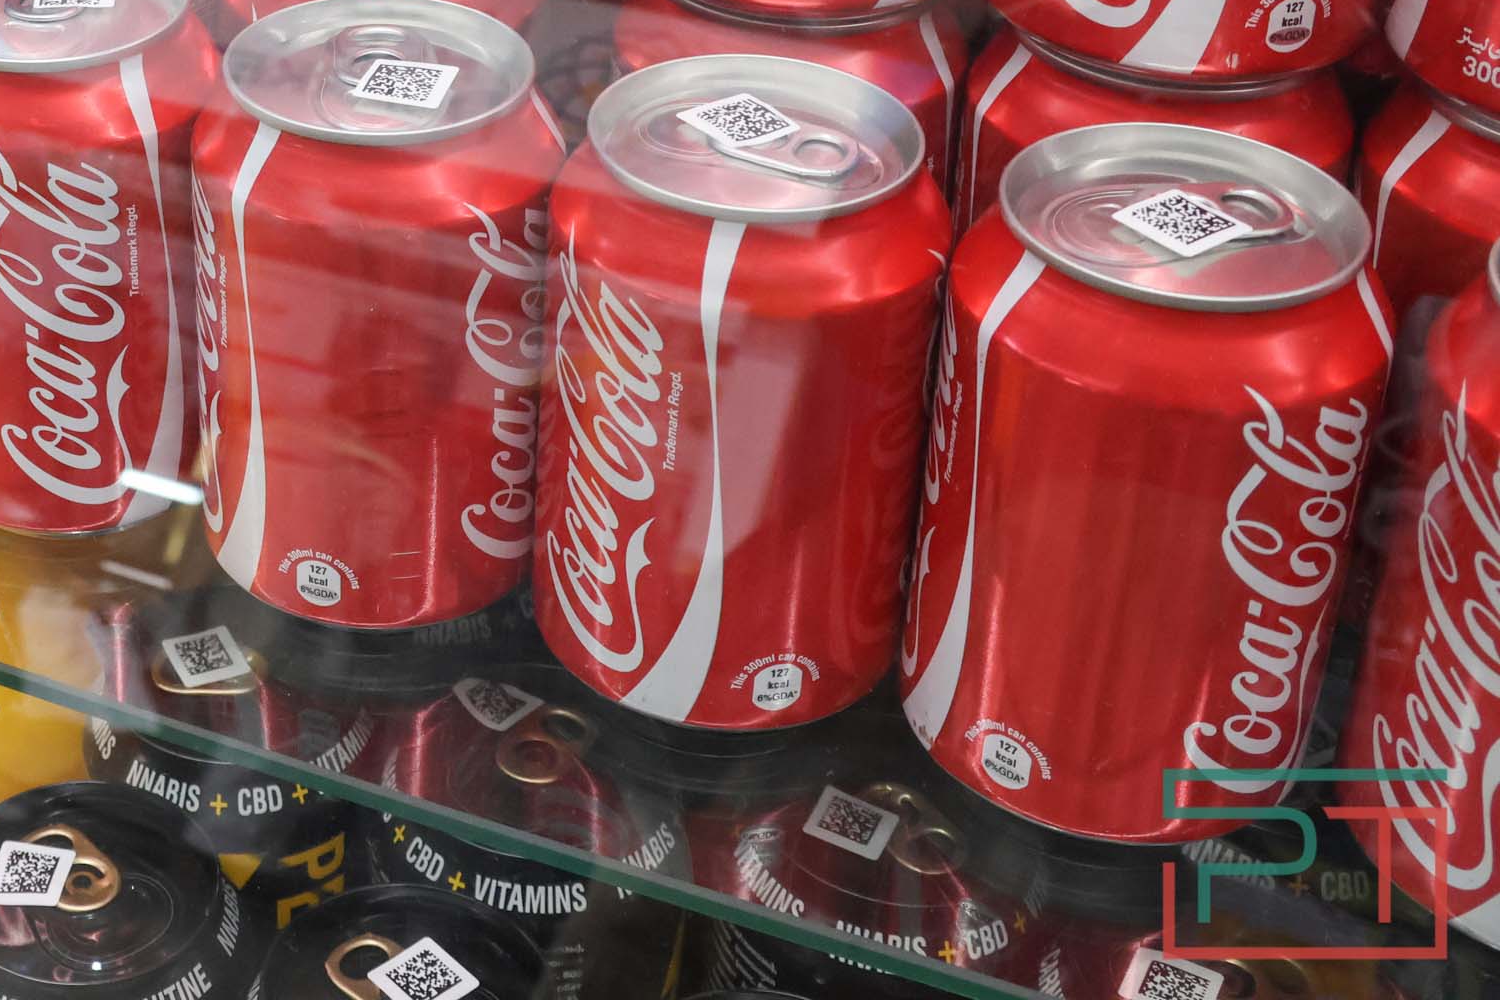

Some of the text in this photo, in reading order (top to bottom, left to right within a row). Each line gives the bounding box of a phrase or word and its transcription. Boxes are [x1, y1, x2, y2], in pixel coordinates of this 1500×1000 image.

[1244, 8, 1264, 29] This
[1281, 15, 1304, 27] kcal
[1286, 1, 1305, 13] 127
[126, 203, 140, 297] Trademark Regd.
[219, 289, 229, 349] Trademark
[460, 202, 550, 560] Coca-Cola
[661, 371, 683, 472] Trademark Regd.
[547, 219, 664, 673] Coca-Cola
[308, 575, 329, 587] kcal
[310, 564, 328, 576] 127
[315, 551, 333, 562] can
[333, 559, 361, 590] contains
[1183, 384, 1369, 794] Coca-Cola
[730, 672, 749, 690] This
[743, 653, 776, 674] 300ml
[778, 653, 797, 663] can
[767, 679, 790, 690] kcal
[770, 667, 790, 678] 127
[995, 750, 1017, 768] kcal
[999, 739, 1018, 755] 127
[1007, 727, 1053, 781] can contains
[237, 784, 285, 817] CBD
[405, 836, 588, 915] CBD VITAMINS
[1320, 870, 1370, 902] CBD
[963, 919, 1010, 961] CBD
